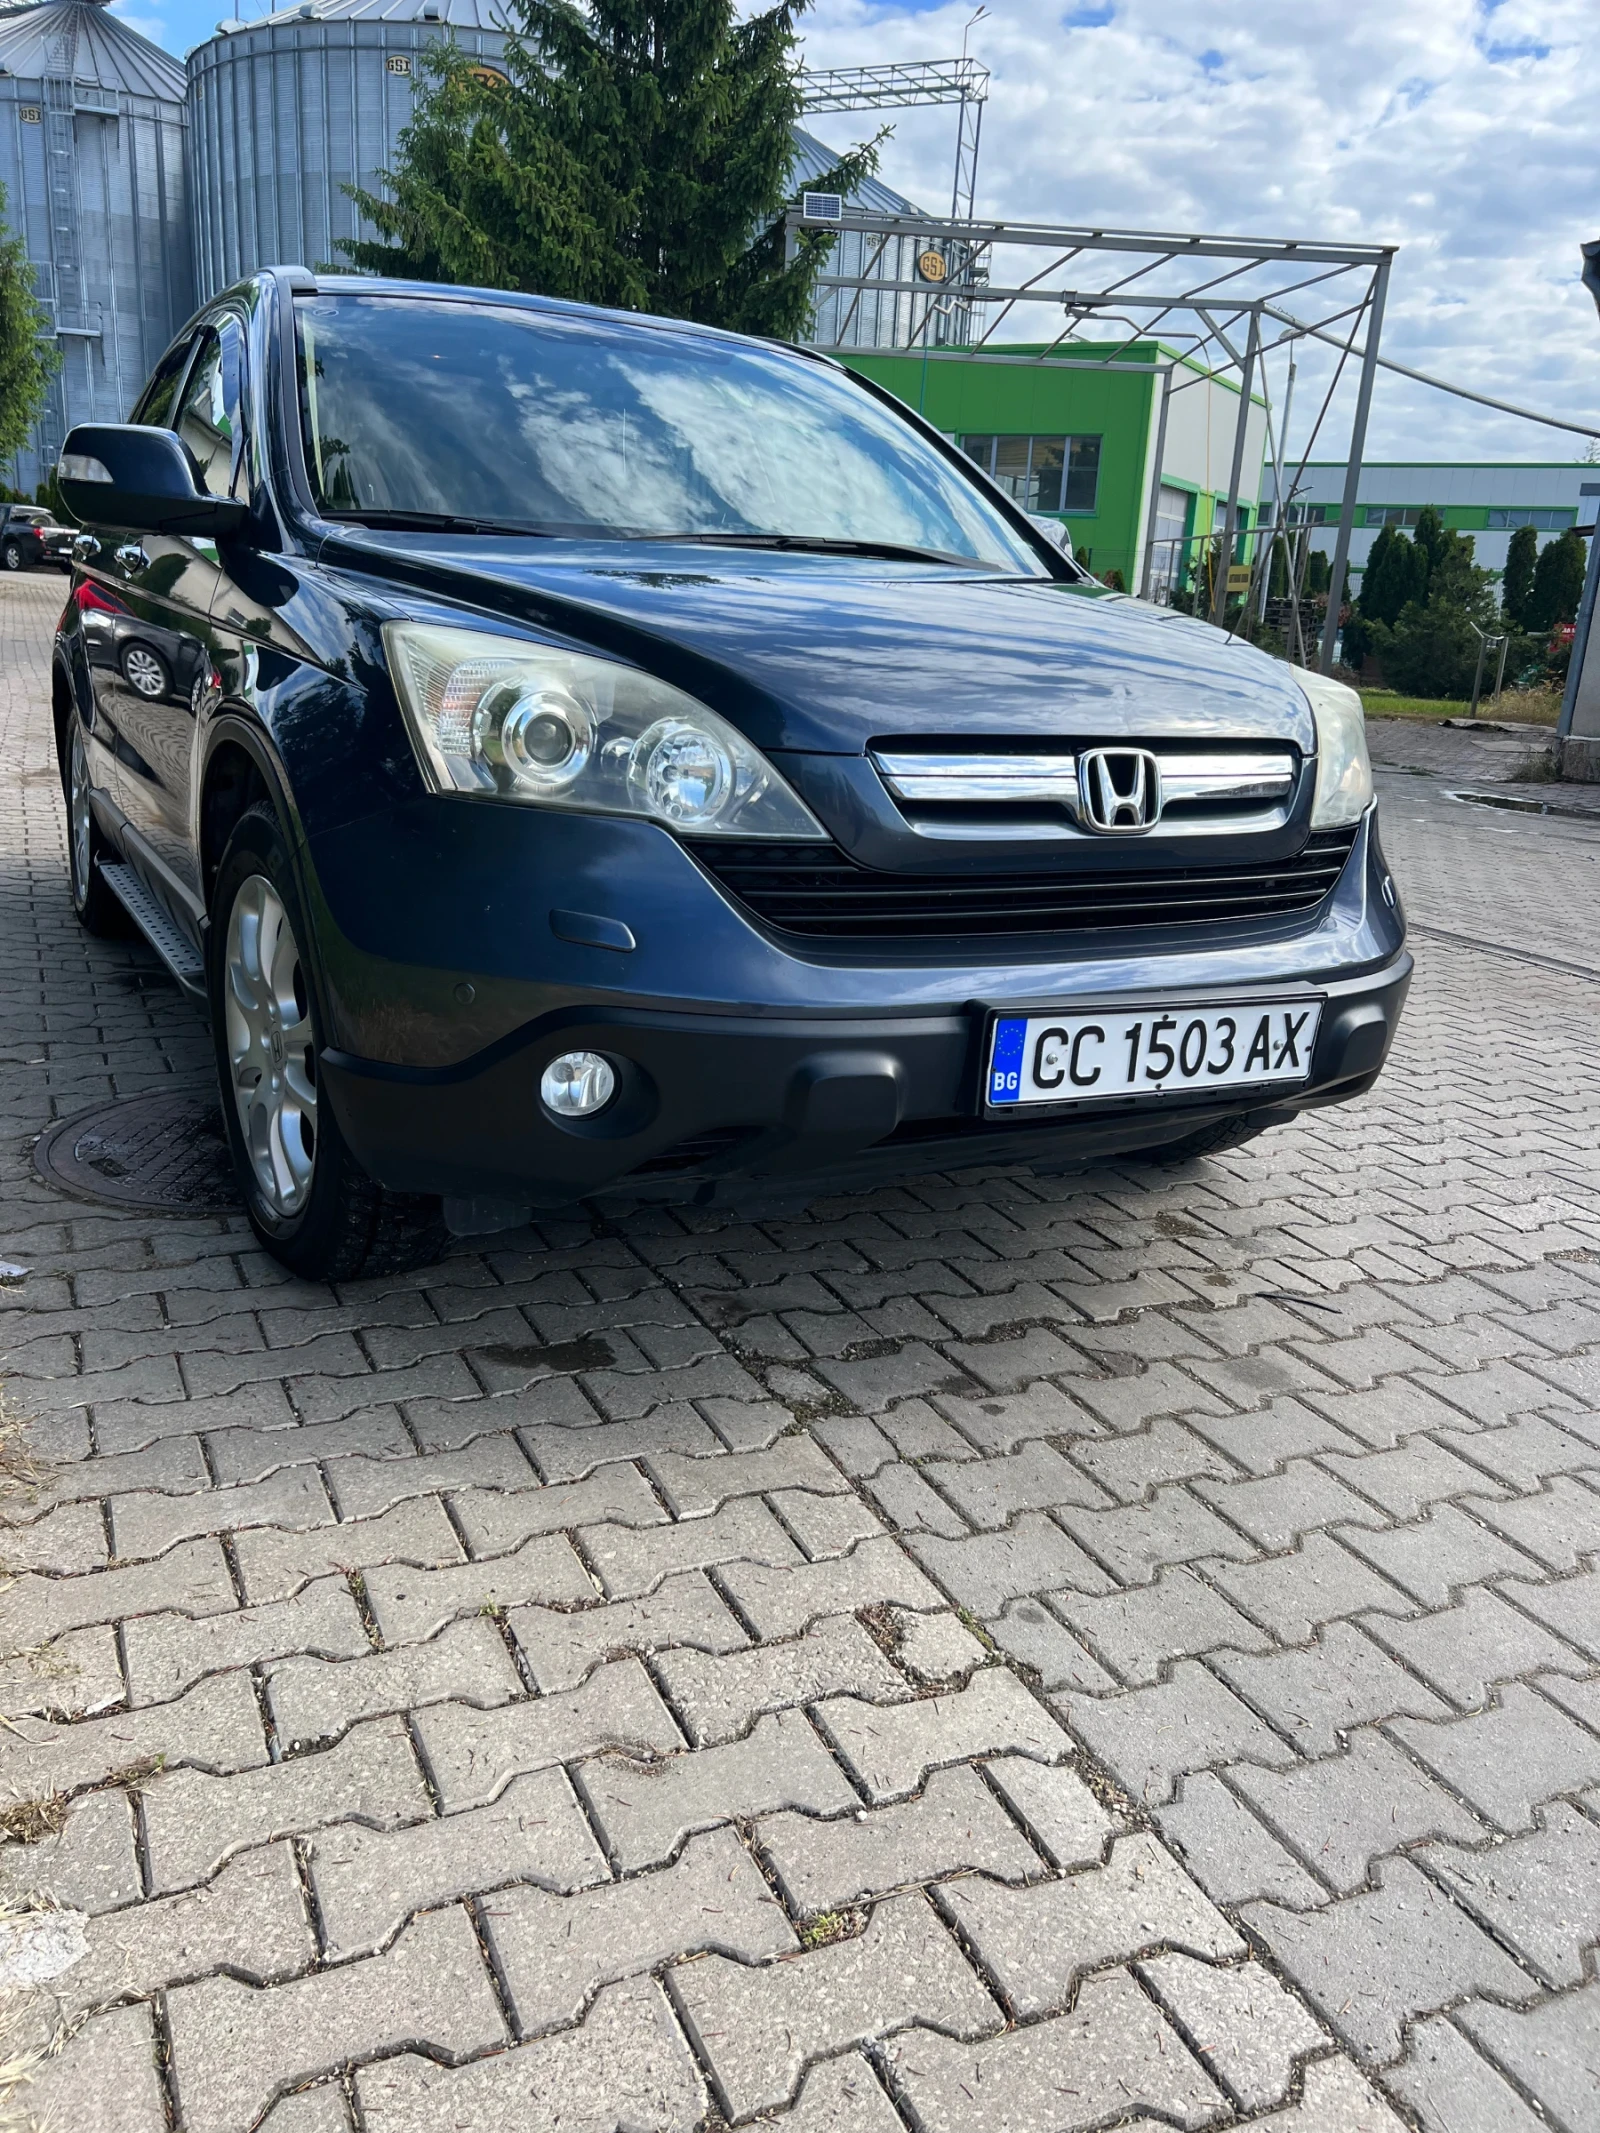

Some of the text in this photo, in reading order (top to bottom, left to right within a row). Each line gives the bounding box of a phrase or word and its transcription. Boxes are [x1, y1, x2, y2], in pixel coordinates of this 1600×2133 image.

[387, 58, 411, 72] GSI
[21, 109, 42, 121] GSI
[922, 256, 944, 276] GSI
[1032, 1011, 1310, 1090] CC 1503 AX
[993, 1071, 1019, 1092] BG
